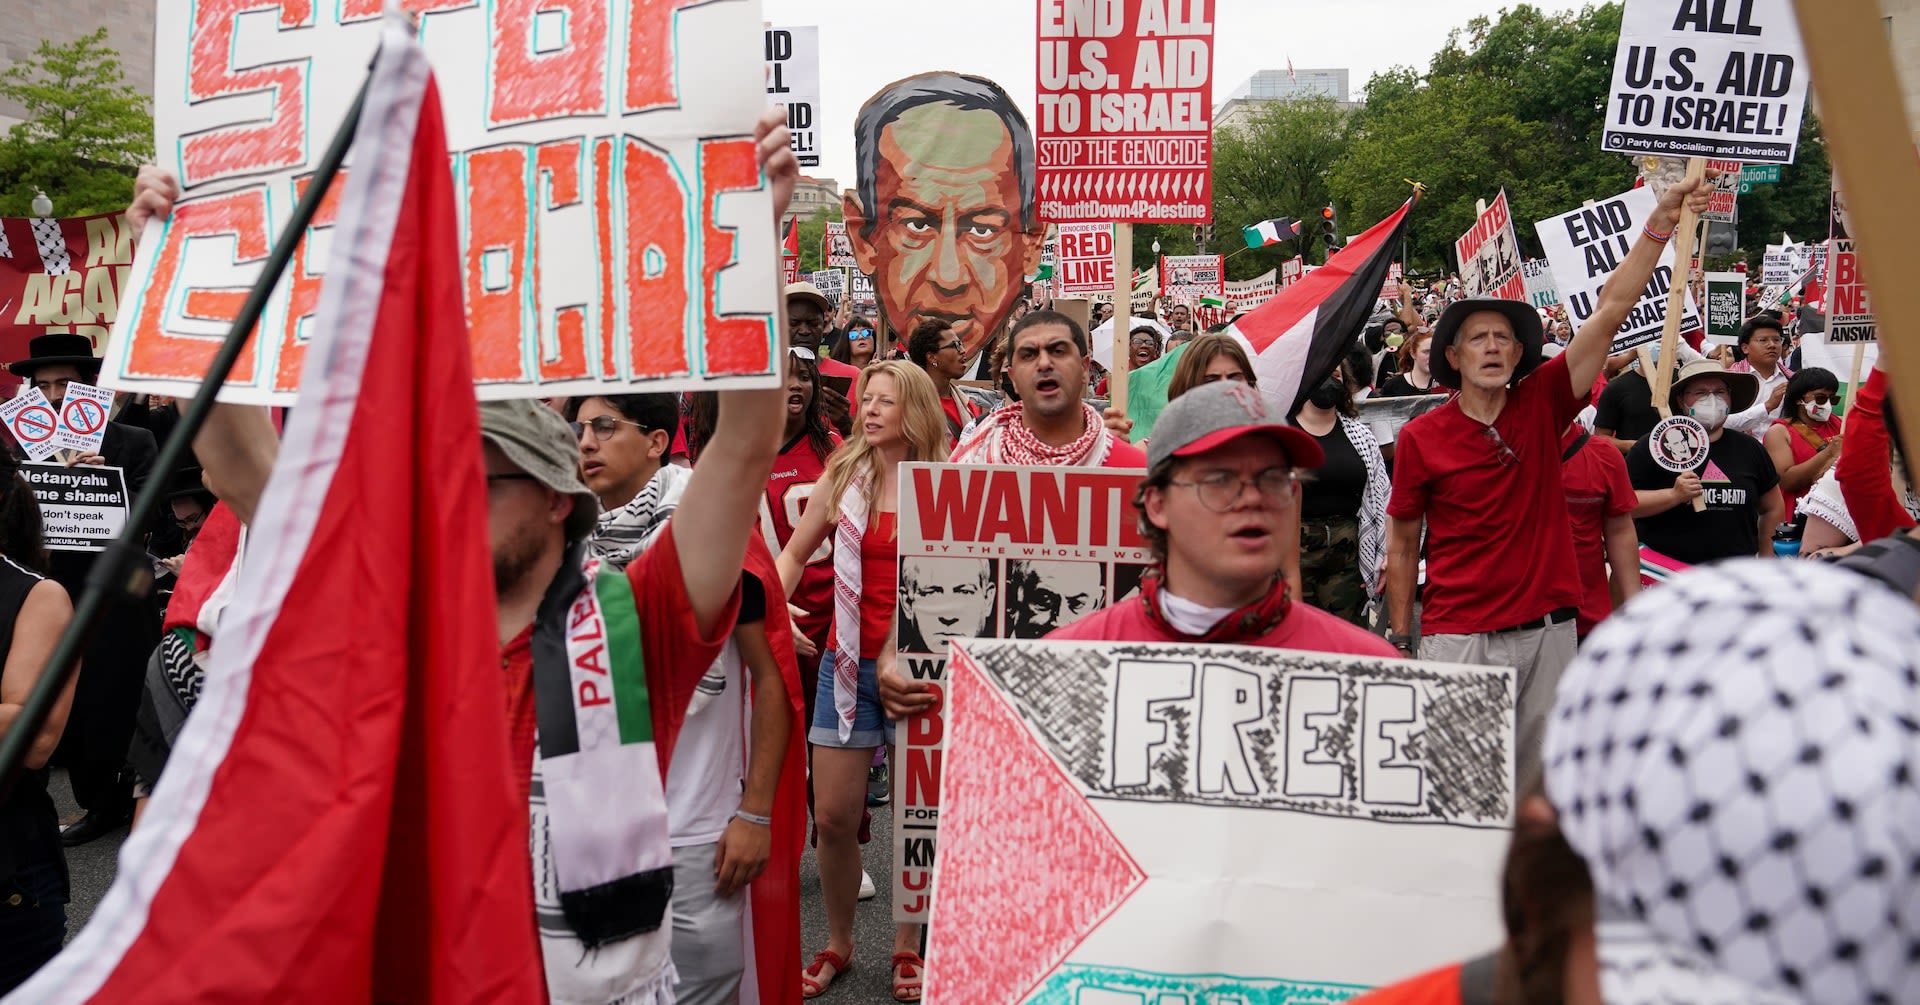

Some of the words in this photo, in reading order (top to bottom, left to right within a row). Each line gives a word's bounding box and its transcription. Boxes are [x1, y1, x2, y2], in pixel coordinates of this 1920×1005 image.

[1039, 0, 1124, 37] END
[1136, 0, 1212, 37] ALL
[1672, 0, 1762, 36] ALL
[1039, 41, 1119, 90] U.S.
[1131, 39, 1209, 89] AID
[1625, 46, 1704, 93] U.S.
[1716, 51, 1794, 98] AID
[786, 102, 812, 129] ID
[1038, 93, 1081, 133] TO
[1090, 92, 1208, 133] ISRAEL
[1617, 93, 1654, 126] TO
[1661, 96, 1788, 136] ISRAEL!
[1040, 140, 1082, 166] STOP
[1087, 140, 1118, 165] THE
[1122, 139, 1208, 165] GENOCIDE
[1627, 137, 1652, 149] Party
[1654, 139, 1668, 149] for
[1669, 140, 1715, 153] Socialism
[1716, 145, 1735, 154] and
[1737, 146, 1787, 157] Liberation
[1706, 160, 1740, 172] ANTED
[1741, 167, 1767, 181] tution
[1708, 201, 1733, 213] NYAHU
[1711, 192, 1735, 204] AMIN
[1040, 200, 1207, 219] #ShutItDown4Palestine
[1060, 224, 1090, 233] GENOCIDE
[1098, 223, 1112, 231] OUR
[1459, 194, 1507, 265] WANTED
[1563, 200, 1632, 248] END
[1061, 231, 1112, 257] RED
[1062, 260, 1115, 284] LINE
[1487, 265, 1520, 293] RIMINAL
[1226, 289, 1273, 300] PALESTINE
[1833, 285, 1867, 315] NE
[70, 383, 97, 394] JUDAISM
[70, 389, 97, 399] ZIONISM
[4, 400, 29, 416] ZIONISM
[1658, 456, 1680, 469] ARREST
[64, 489, 122, 503] shame!
[43, 510, 71, 519] don't
[73, 511, 104, 522] speak
[44, 524, 80, 534] Jewish
[82, 525, 111, 535] name
[925, 545, 950, 554] BY
[967, 546, 1006, 556] THE
[1023, 548, 1097, 559] WHOLE
[1114, 551, 1143, 560] WO
[1112, 658, 1424, 807] FREE
